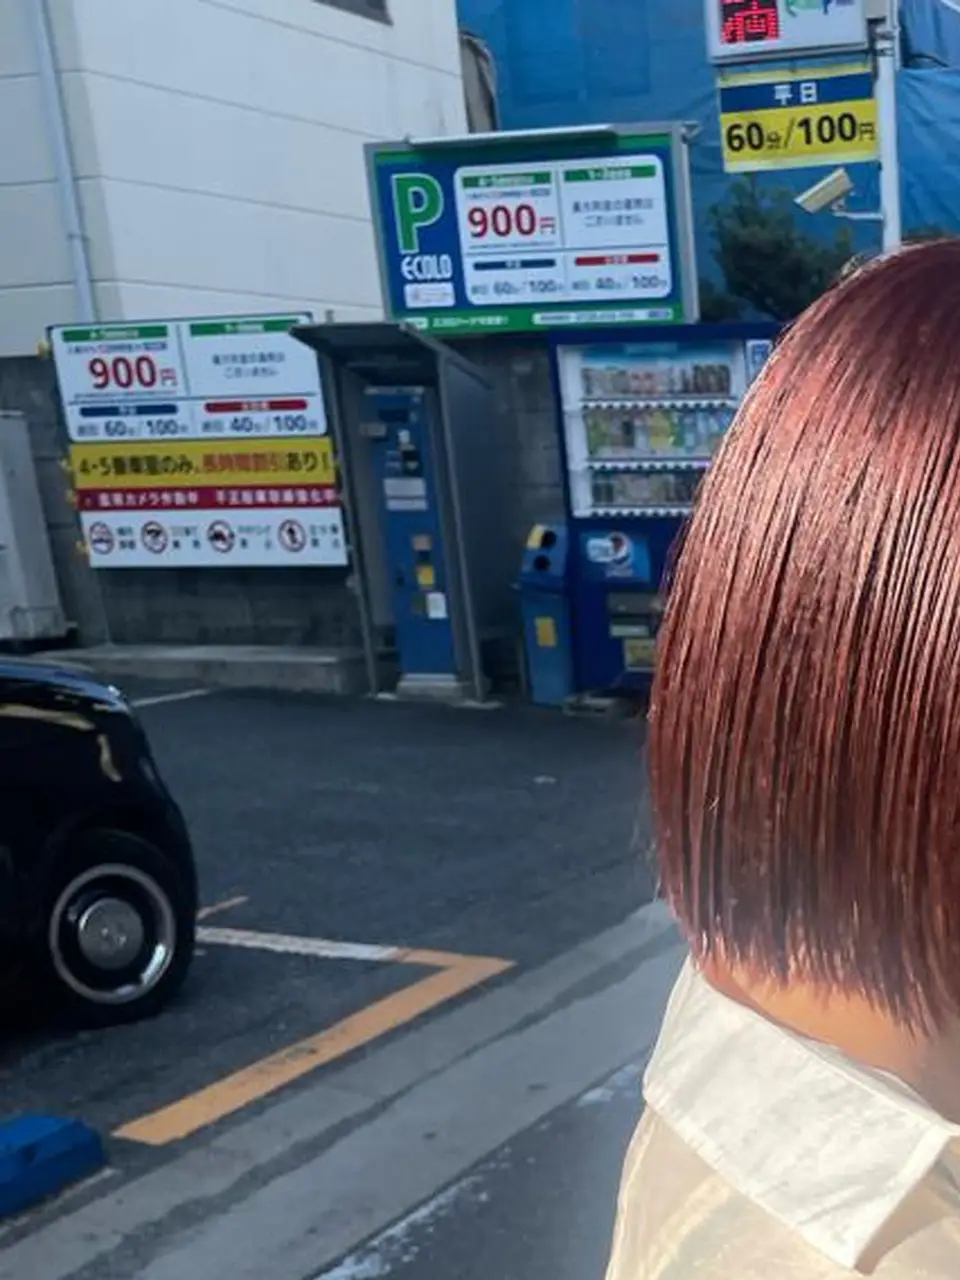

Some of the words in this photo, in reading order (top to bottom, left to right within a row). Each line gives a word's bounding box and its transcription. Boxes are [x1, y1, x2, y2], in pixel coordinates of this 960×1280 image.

[774, 81, 818, 105] 平日
[391, 172, 445, 254] P
[467, 203, 555, 239] 900円
[401, 253, 453, 281] ECOLO
[89, 354, 178, 389] 900円
